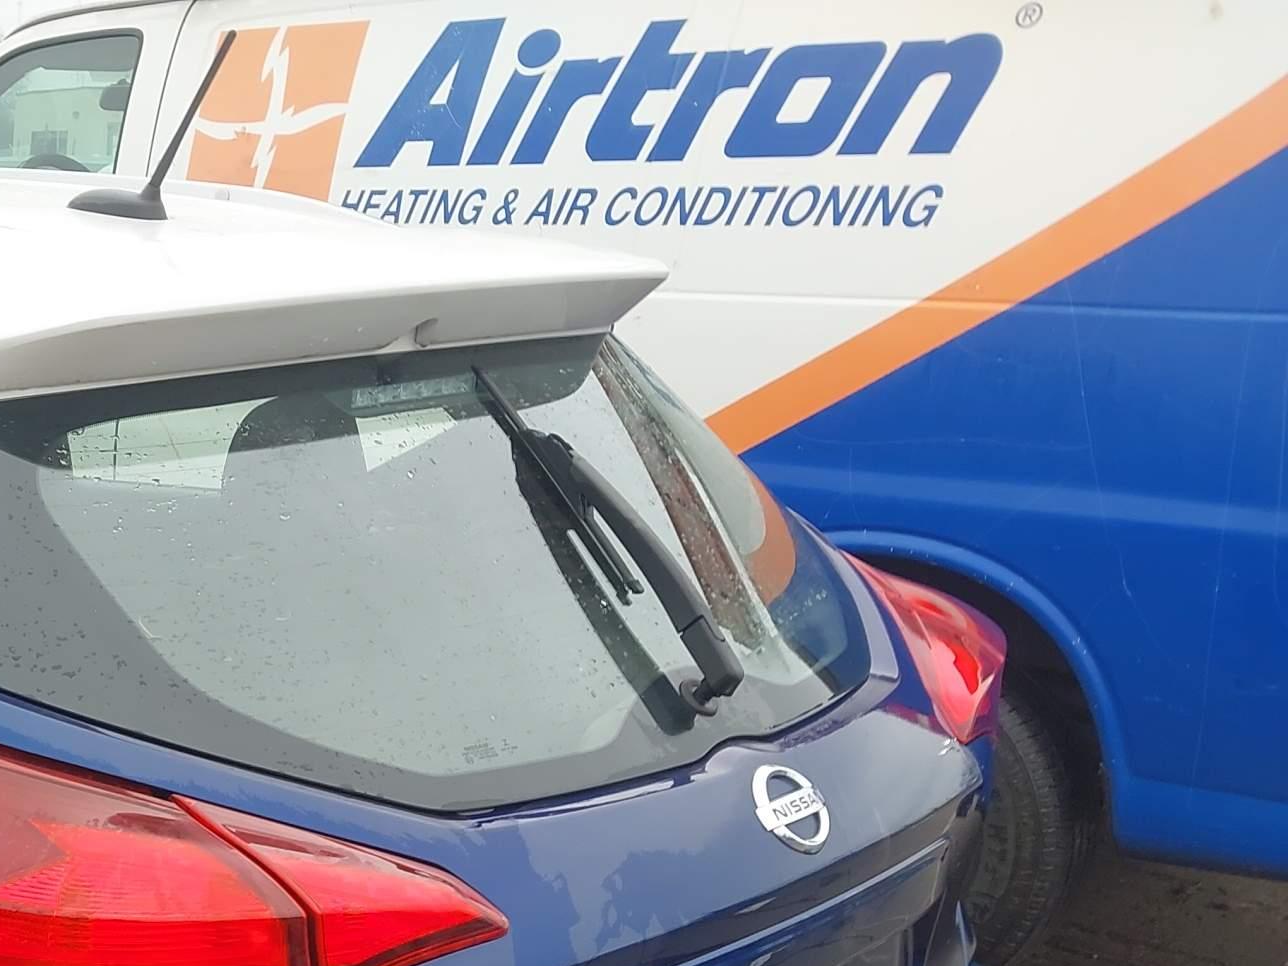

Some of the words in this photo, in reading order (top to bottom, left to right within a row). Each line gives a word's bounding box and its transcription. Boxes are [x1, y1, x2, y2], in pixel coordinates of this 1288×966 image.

[353, 17, 1004, 168] Airtron
[341, 188, 487, 225] HEATING
[491, 187, 520, 225] &
[523, 187, 599, 225] AIR
[604, 184, 945, 227] CONDITIONING
